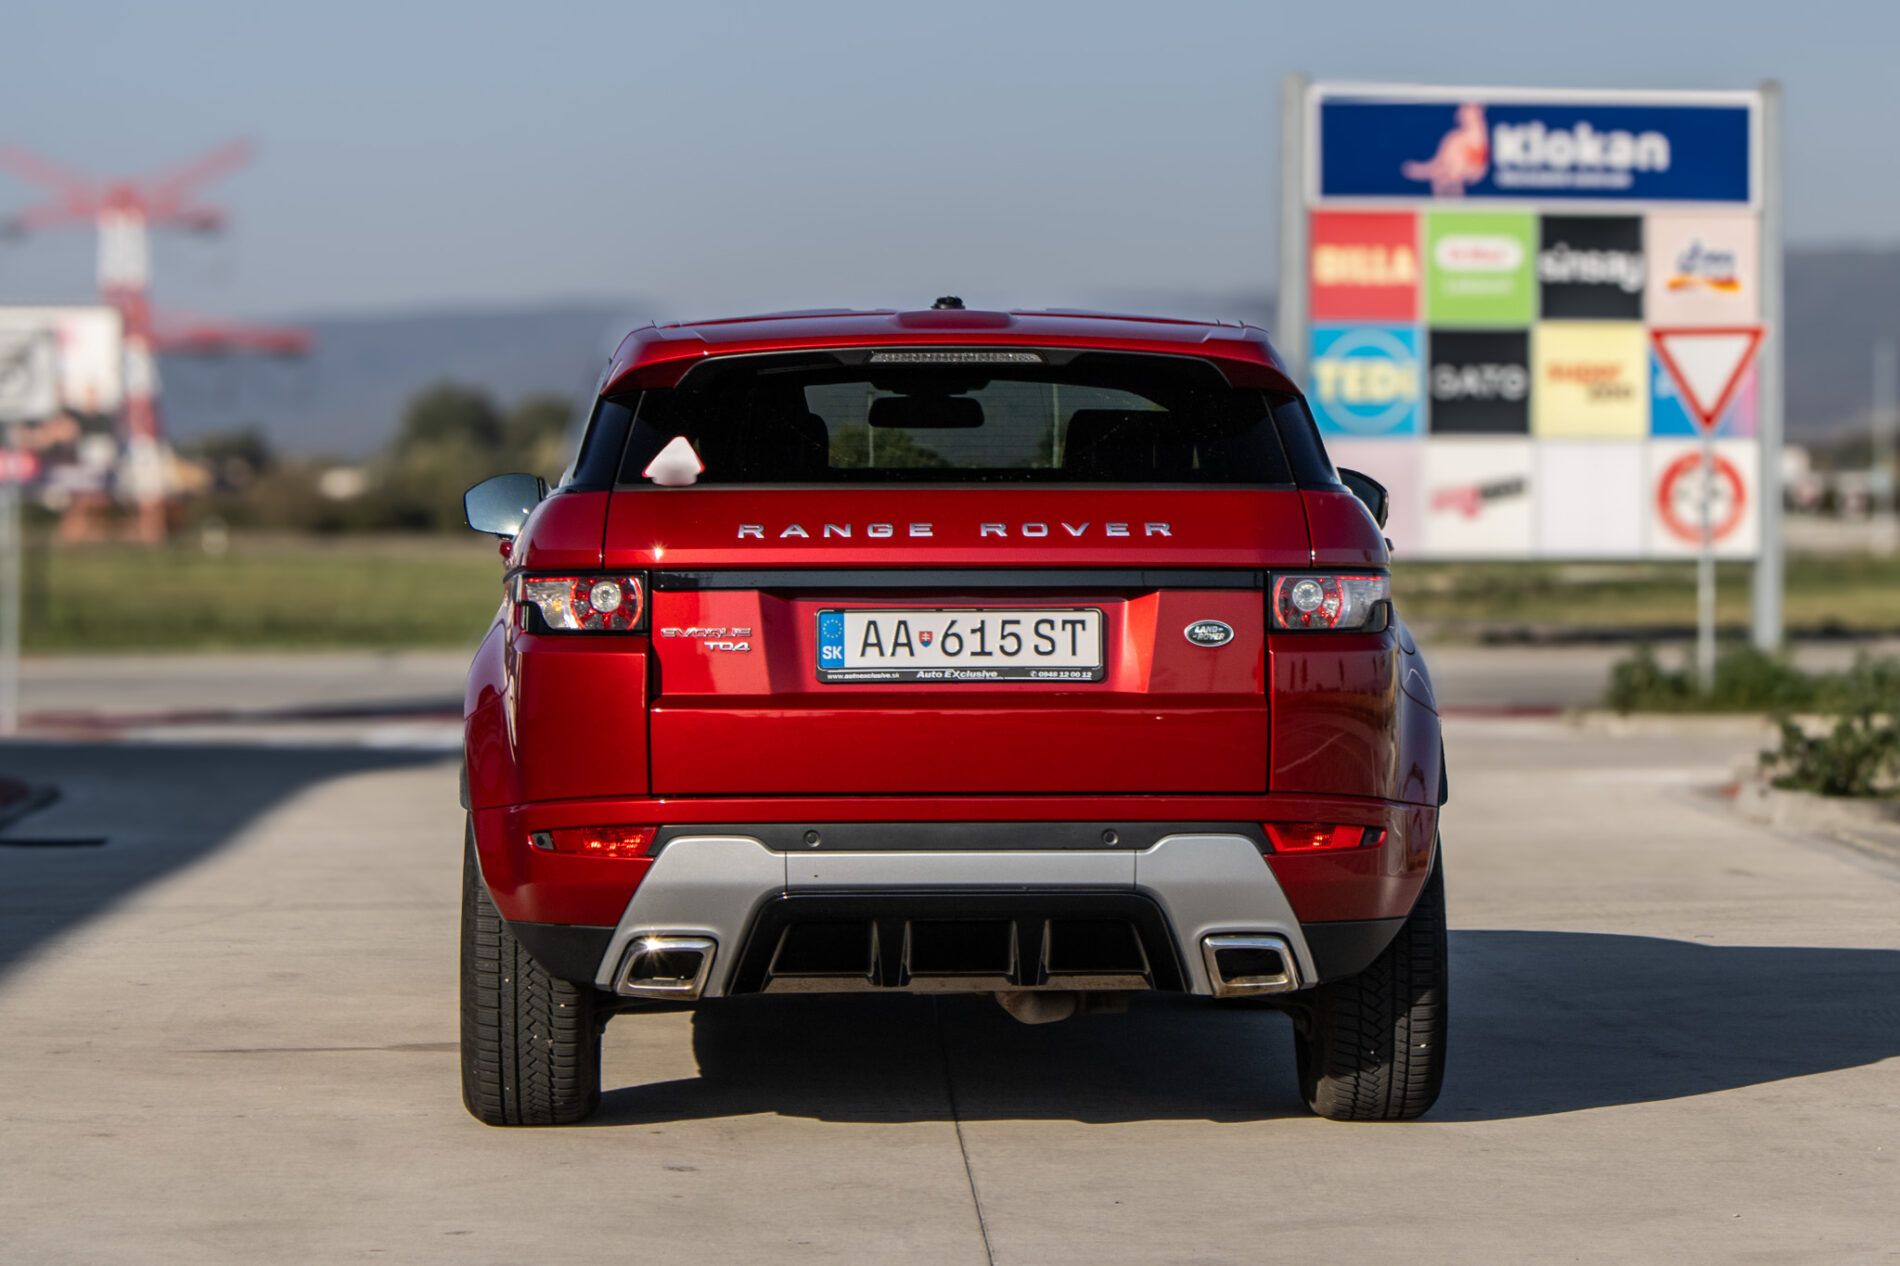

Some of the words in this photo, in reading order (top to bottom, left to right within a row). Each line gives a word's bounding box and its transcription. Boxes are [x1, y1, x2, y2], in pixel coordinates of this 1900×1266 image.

[1494, 121, 1670, 172] Klokan
[1314, 245, 1414, 284] BILLA
[738, 523, 933, 539] RANGE
[980, 522, 1173, 538] ROVER
[660, 627, 753, 638] EVOQUE
[1194, 625, 1218, 633] LAND
[860, 619, 915, 658] AA
[1197, 632, 1226, 640] ROVER
[703, 641, 751, 652] TD4
[822, 646, 843, 660] SK
[916, 670, 943, 679] Auto
